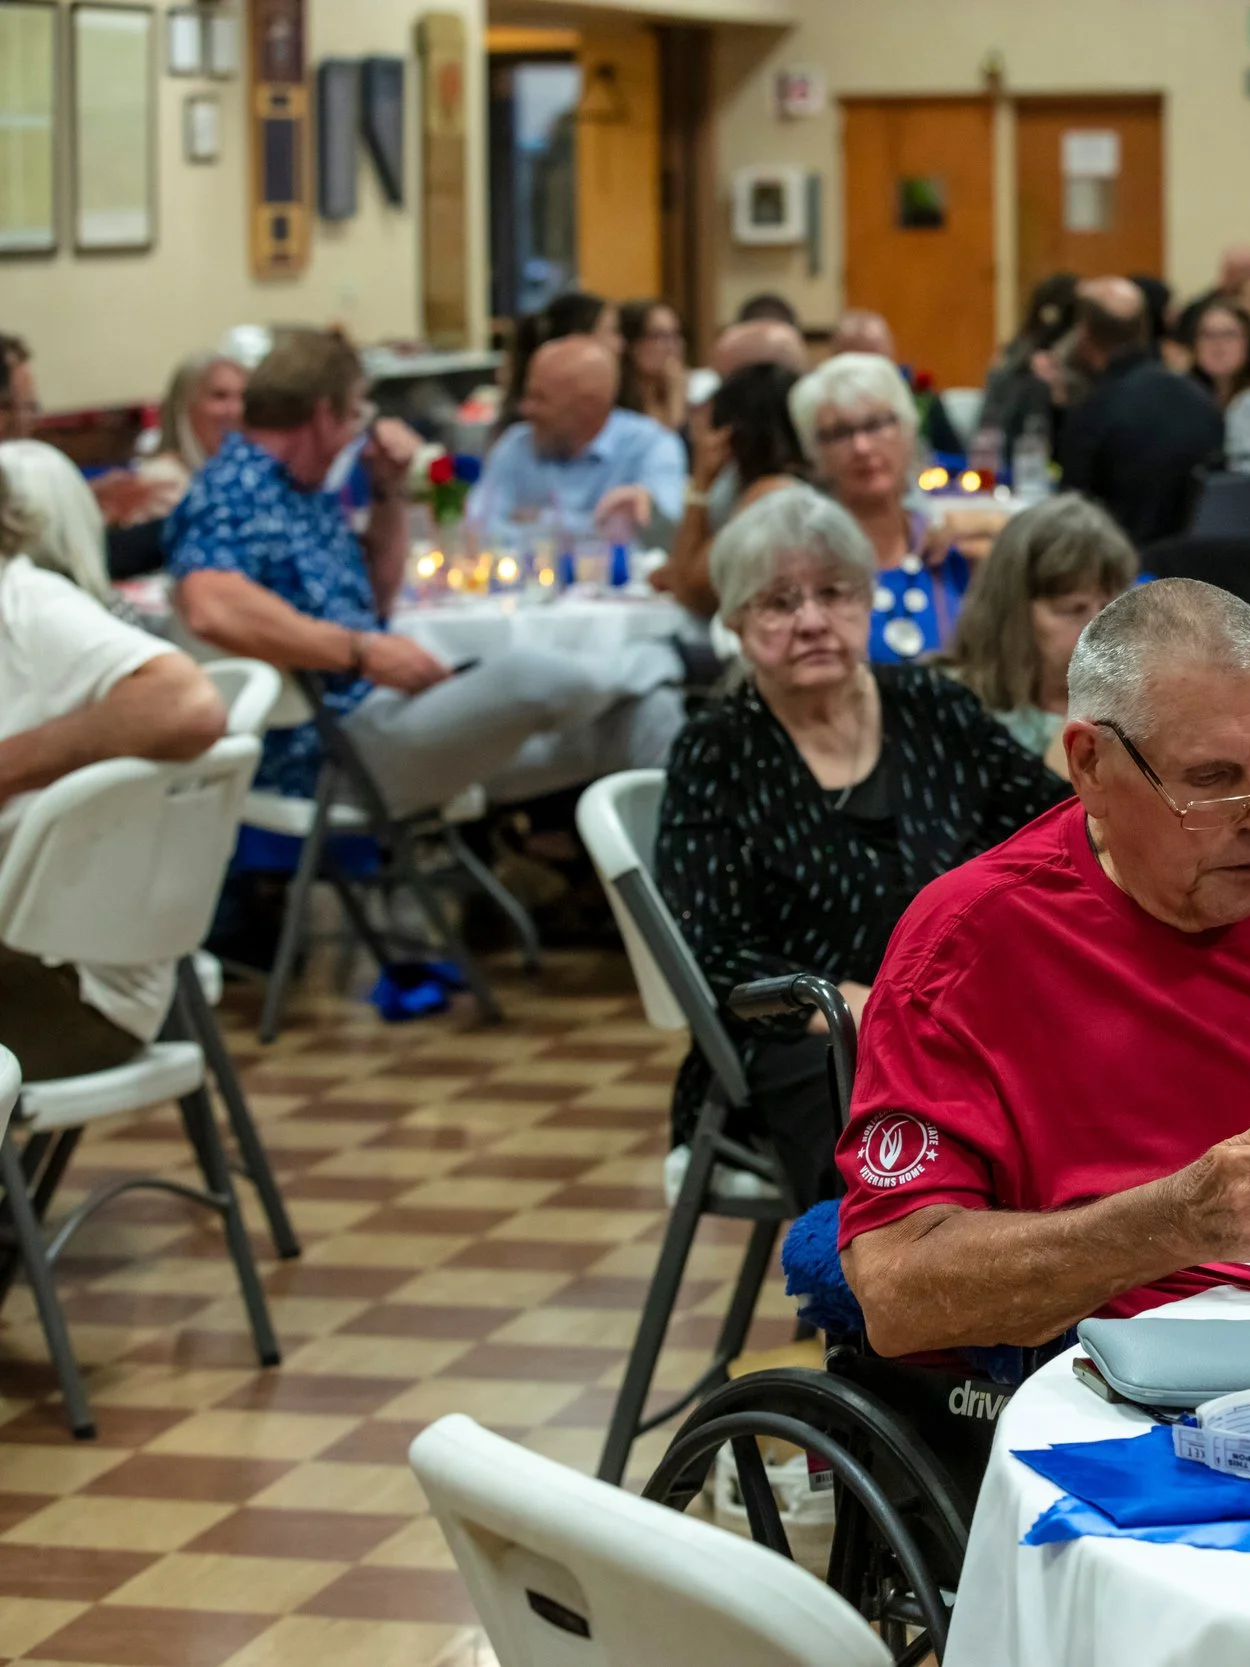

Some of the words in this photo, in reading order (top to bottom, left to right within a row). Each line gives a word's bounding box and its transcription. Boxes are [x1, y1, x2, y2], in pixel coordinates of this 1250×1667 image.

[859, 1165, 897, 1187] VETERANS
[899, 1163, 926, 1185] HOME
[1228, 1459, 1249, 1469] THIS
